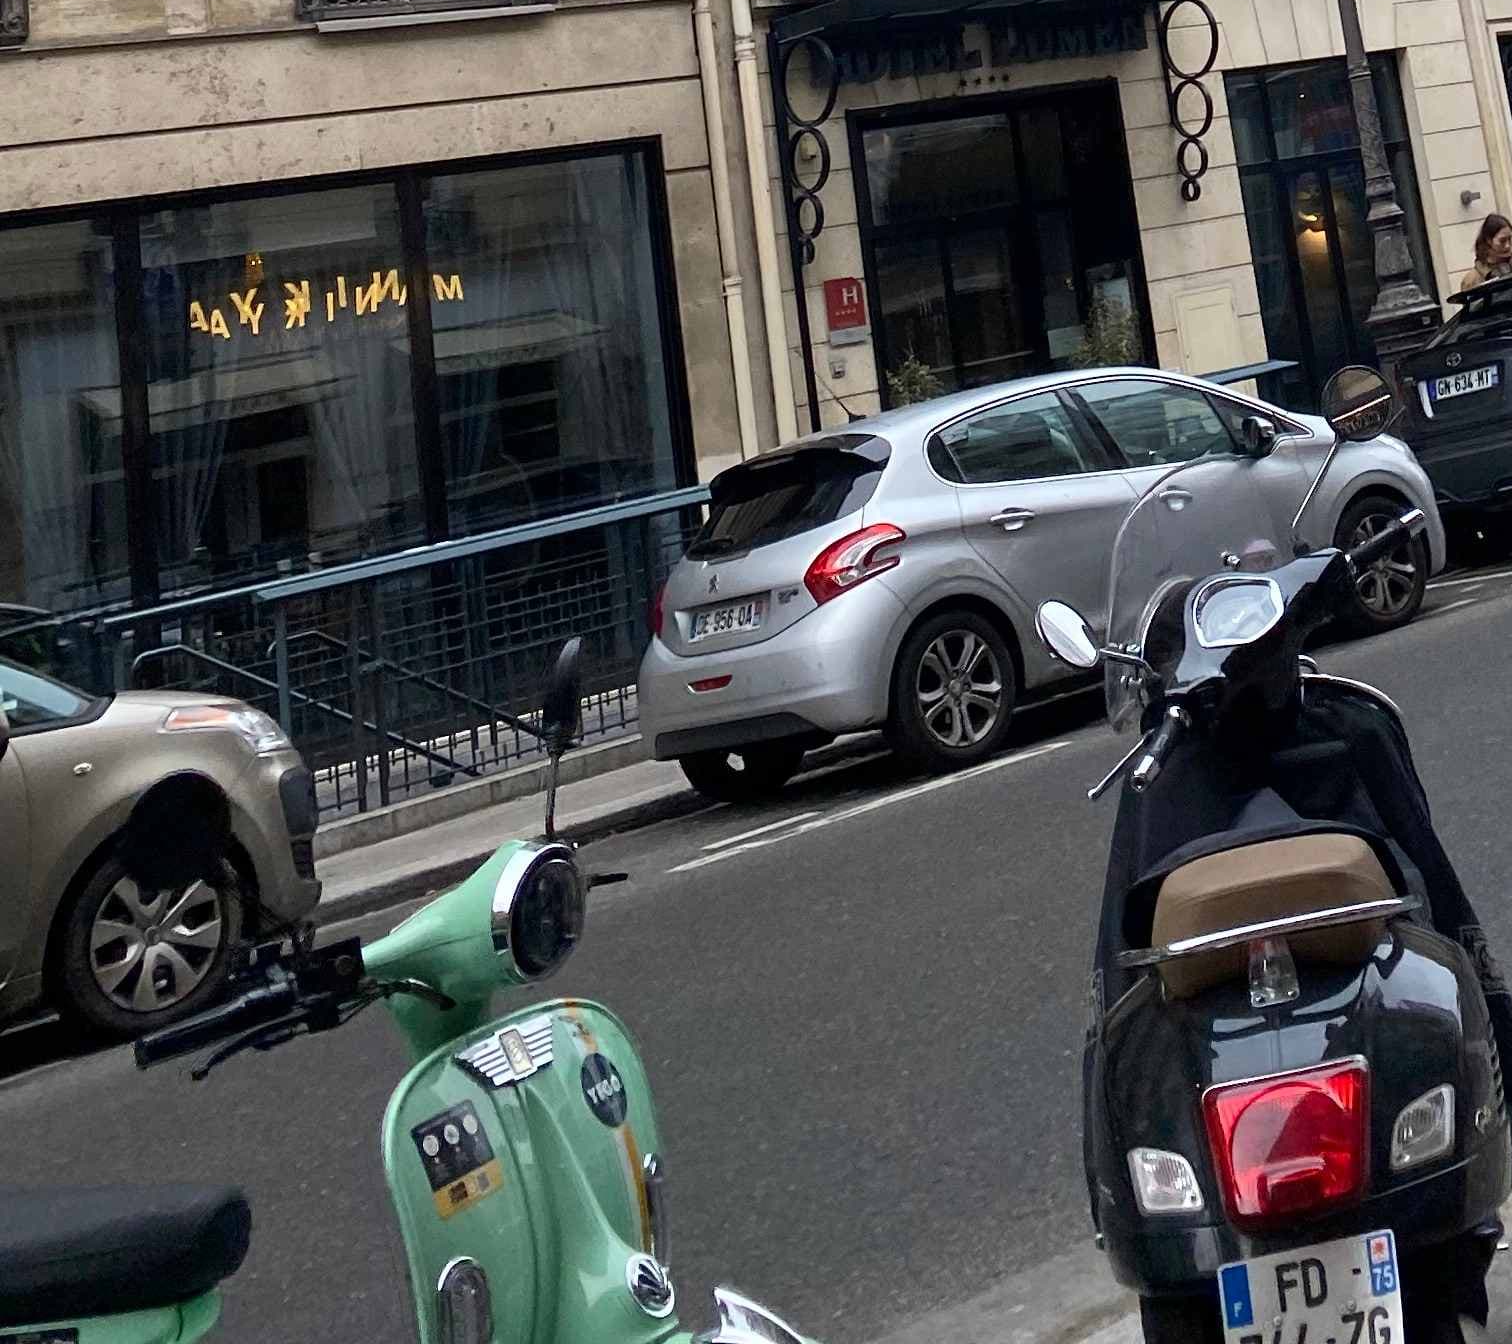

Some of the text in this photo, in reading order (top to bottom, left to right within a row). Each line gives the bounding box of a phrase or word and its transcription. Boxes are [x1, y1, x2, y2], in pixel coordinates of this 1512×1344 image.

[841, 284, 859, 307] H
[1275, 1258, 1328, 1313] FD
[1372, 1265, 1393, 1292] 75
[1233, 1301, 1243, 1318] F
